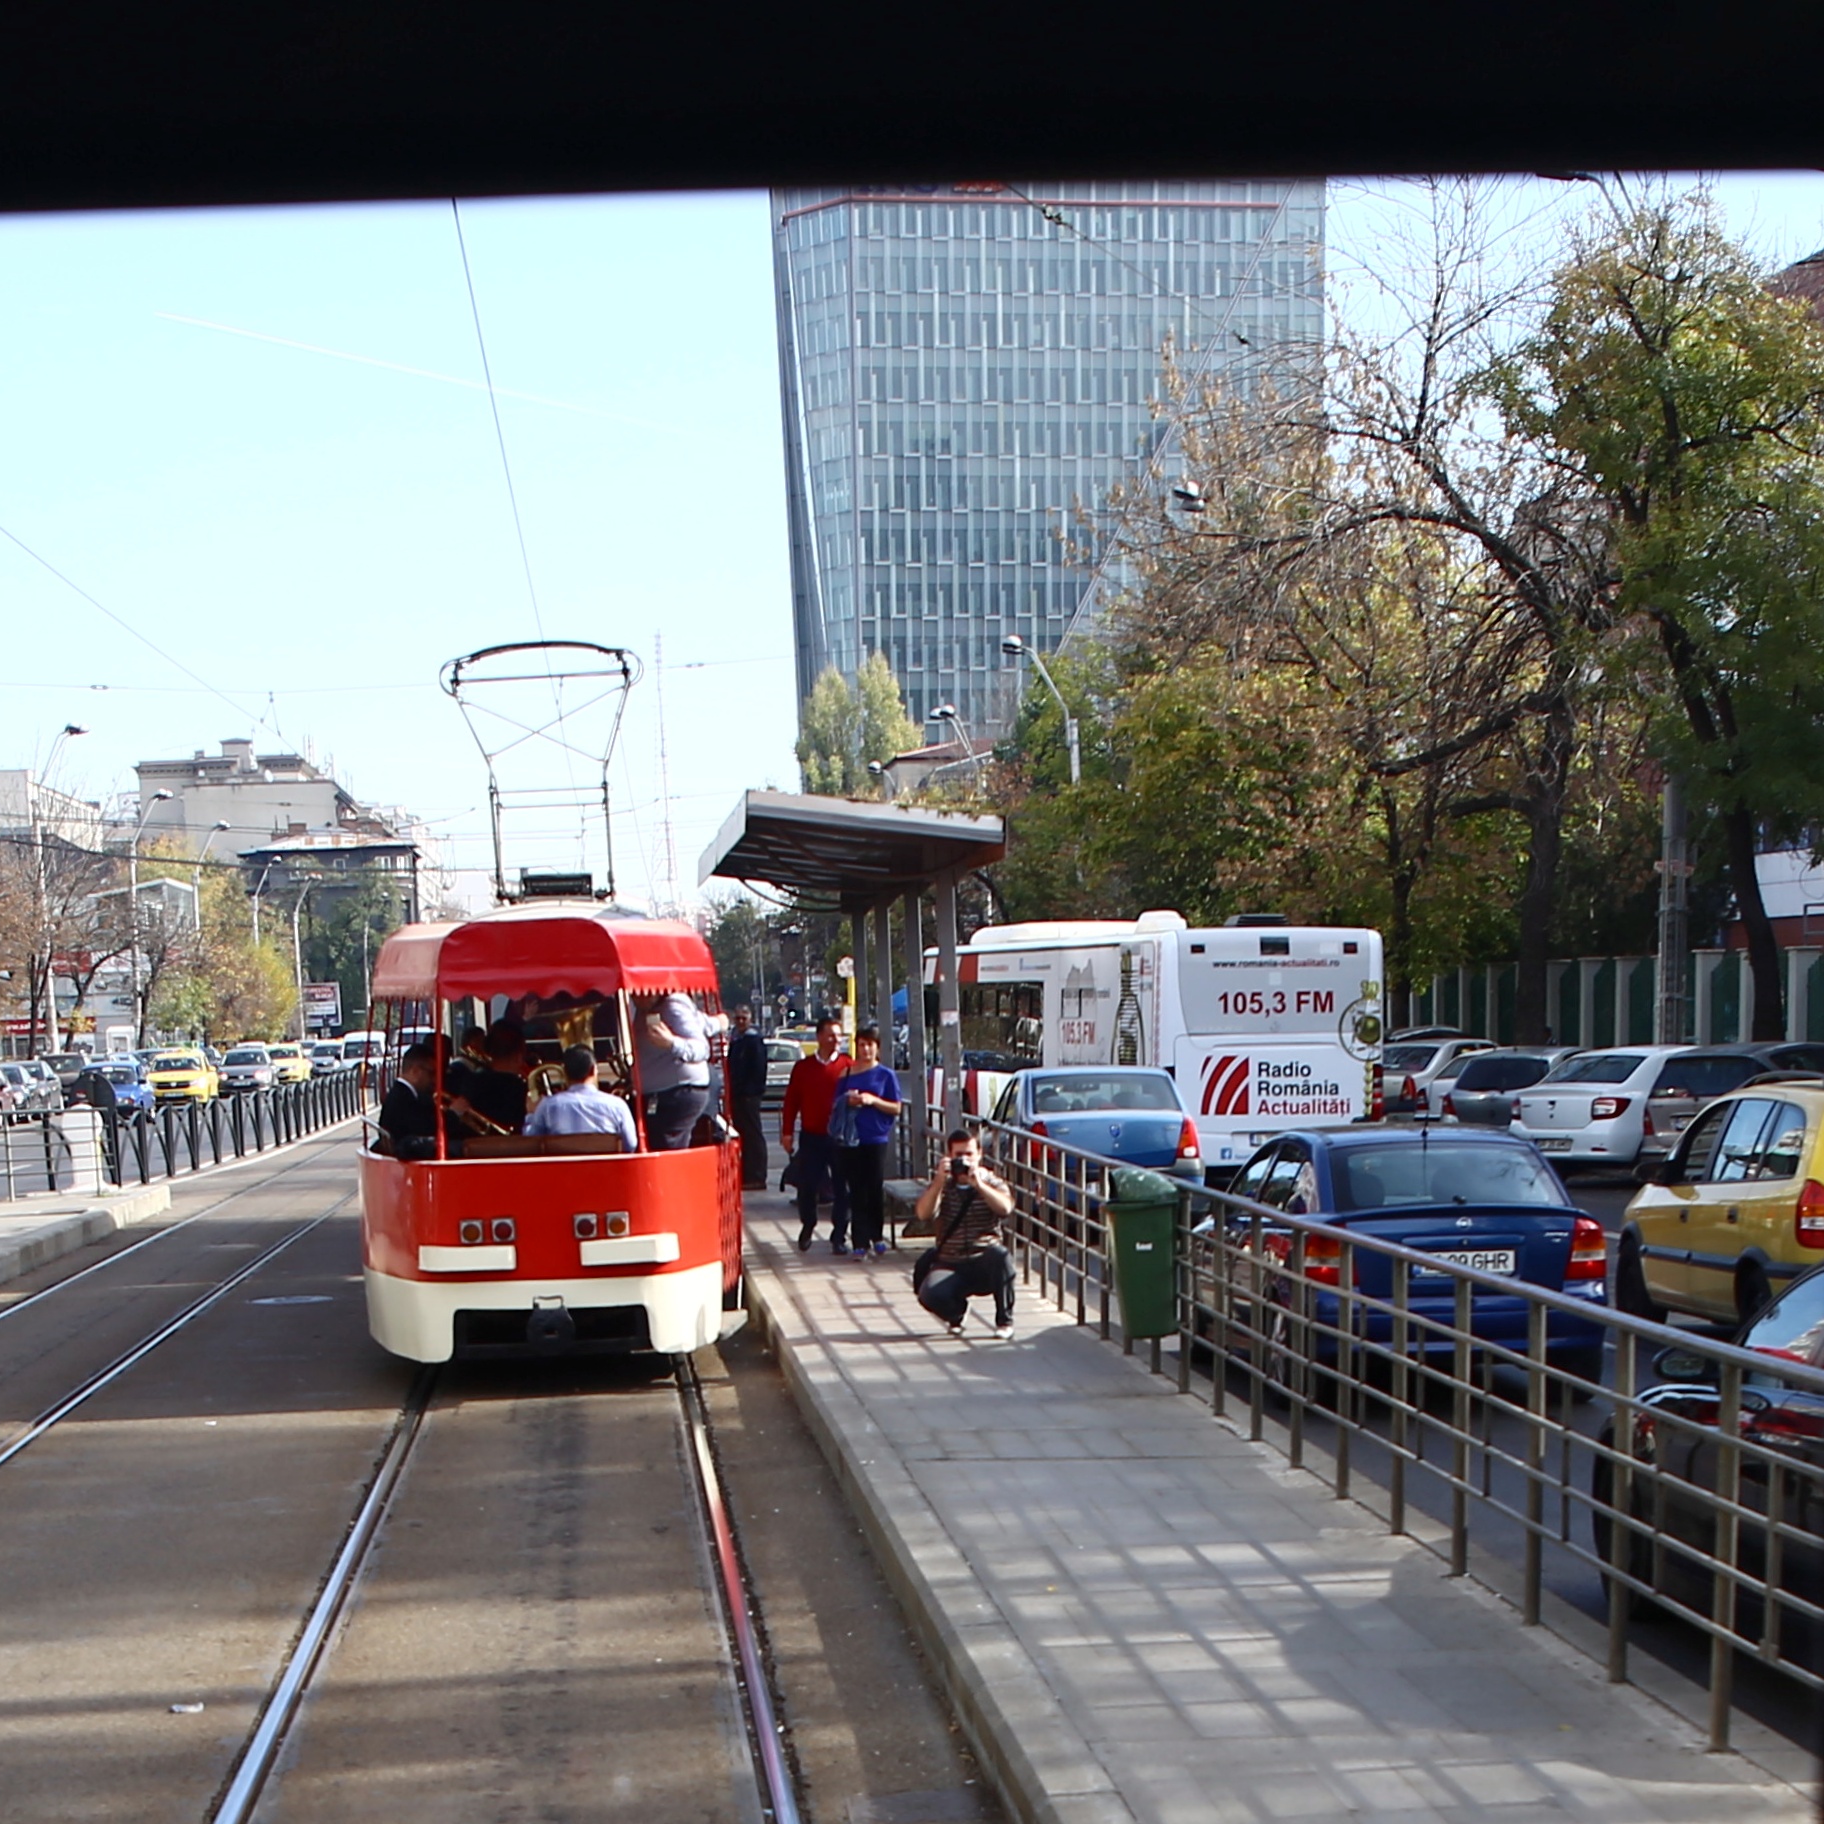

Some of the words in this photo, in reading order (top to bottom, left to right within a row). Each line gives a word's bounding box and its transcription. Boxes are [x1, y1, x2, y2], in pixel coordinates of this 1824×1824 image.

[1212, 959, 1340, 969] www.romania-actualitati.ro
[1217, 990, 1287, 1018] 105,3
[1296, 991, 1334, 1013] FM
[1257, 1061, 1312, 1078] Radio
[1257, 1079, 1340, 1097] România
[1257, 1098, 1351, 1117] Actualități
[1472, 1253, 1509, 1270] GHR
